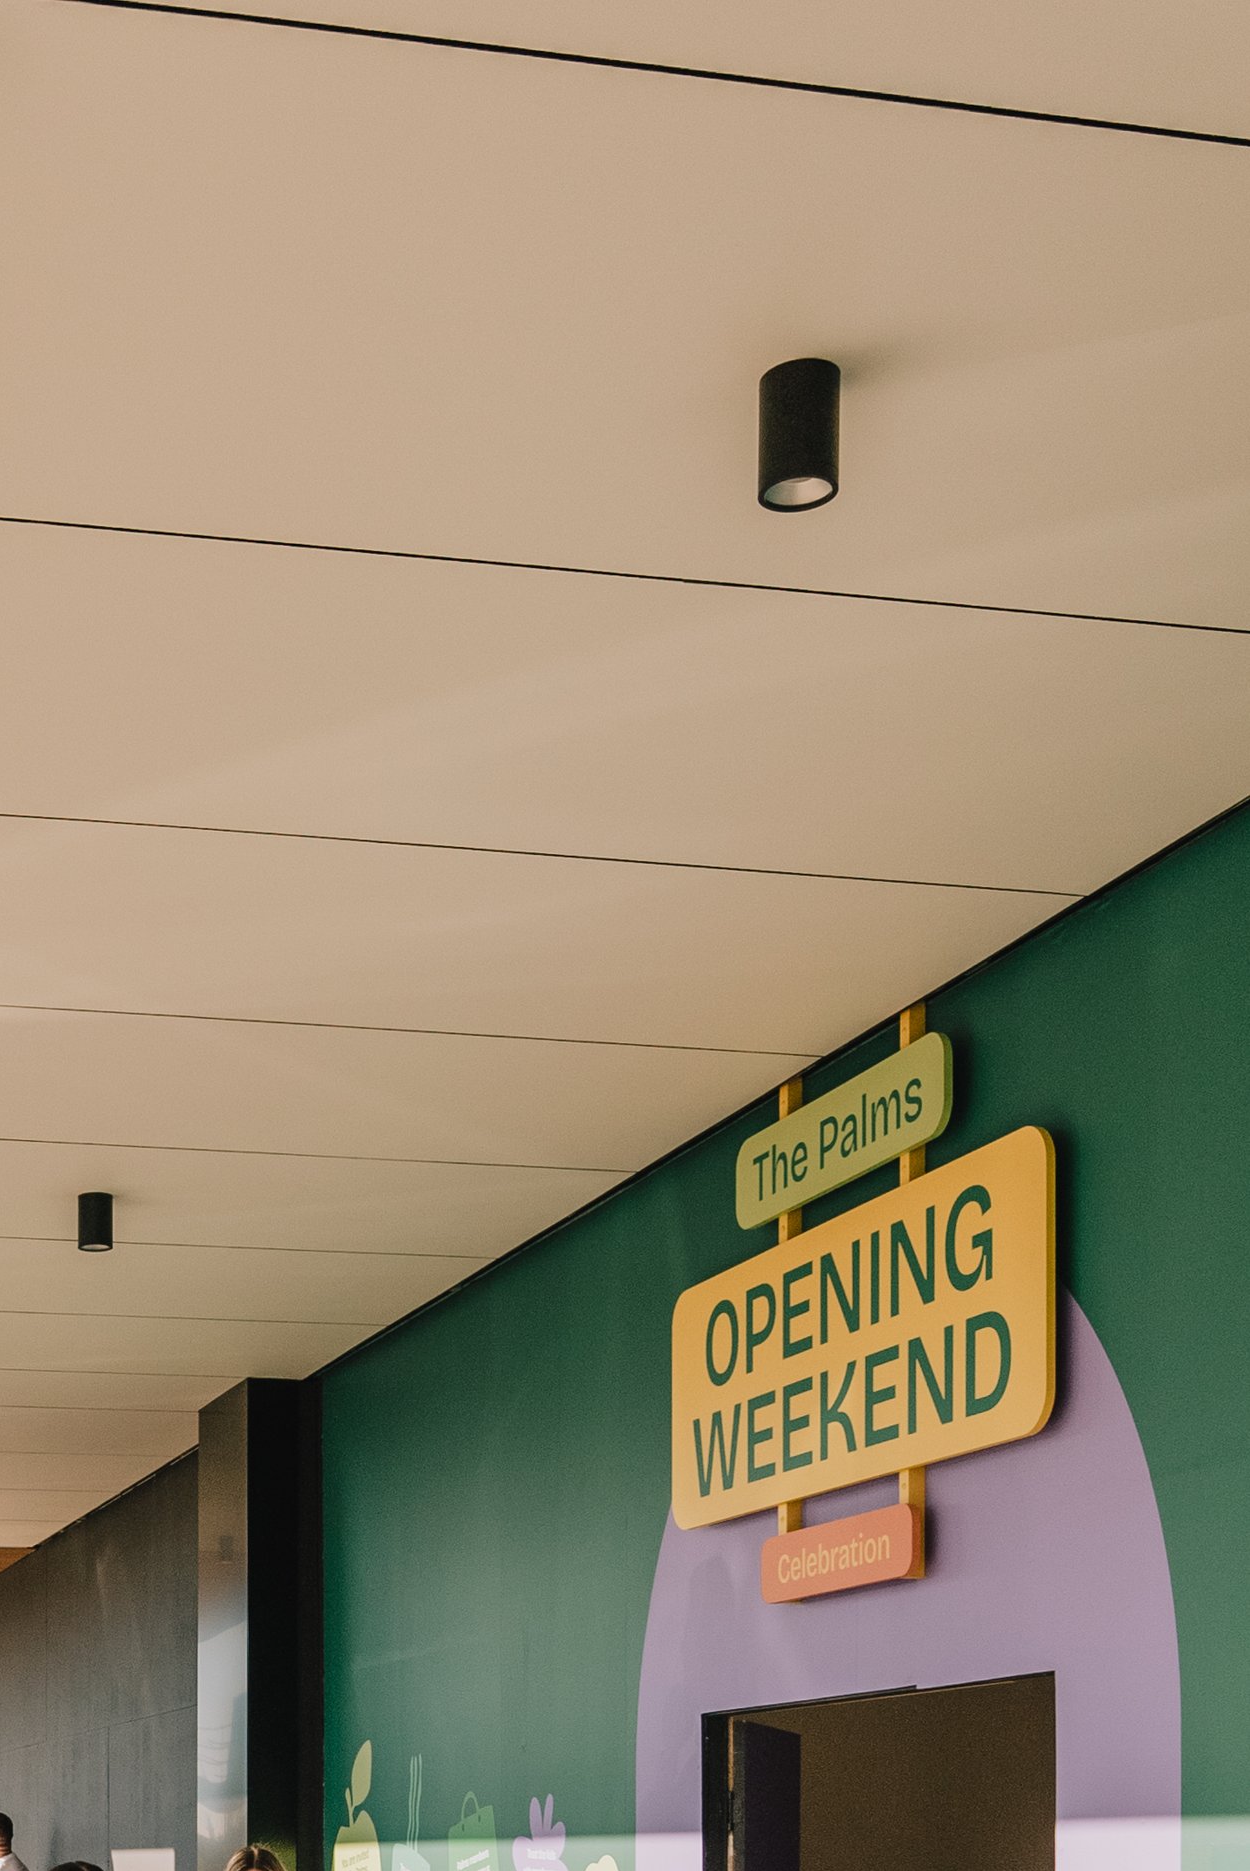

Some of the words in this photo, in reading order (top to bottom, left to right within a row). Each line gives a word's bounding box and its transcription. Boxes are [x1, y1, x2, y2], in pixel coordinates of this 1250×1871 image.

[752, 1142, 808, 1202] The
[818, 1077, 923, 1172] Palms
[705, 1184, 993, 1388] OPENING
[693, 1310, 1013, 1498] WEEKEND
[778, 1532, 891, 1584] Celebration
